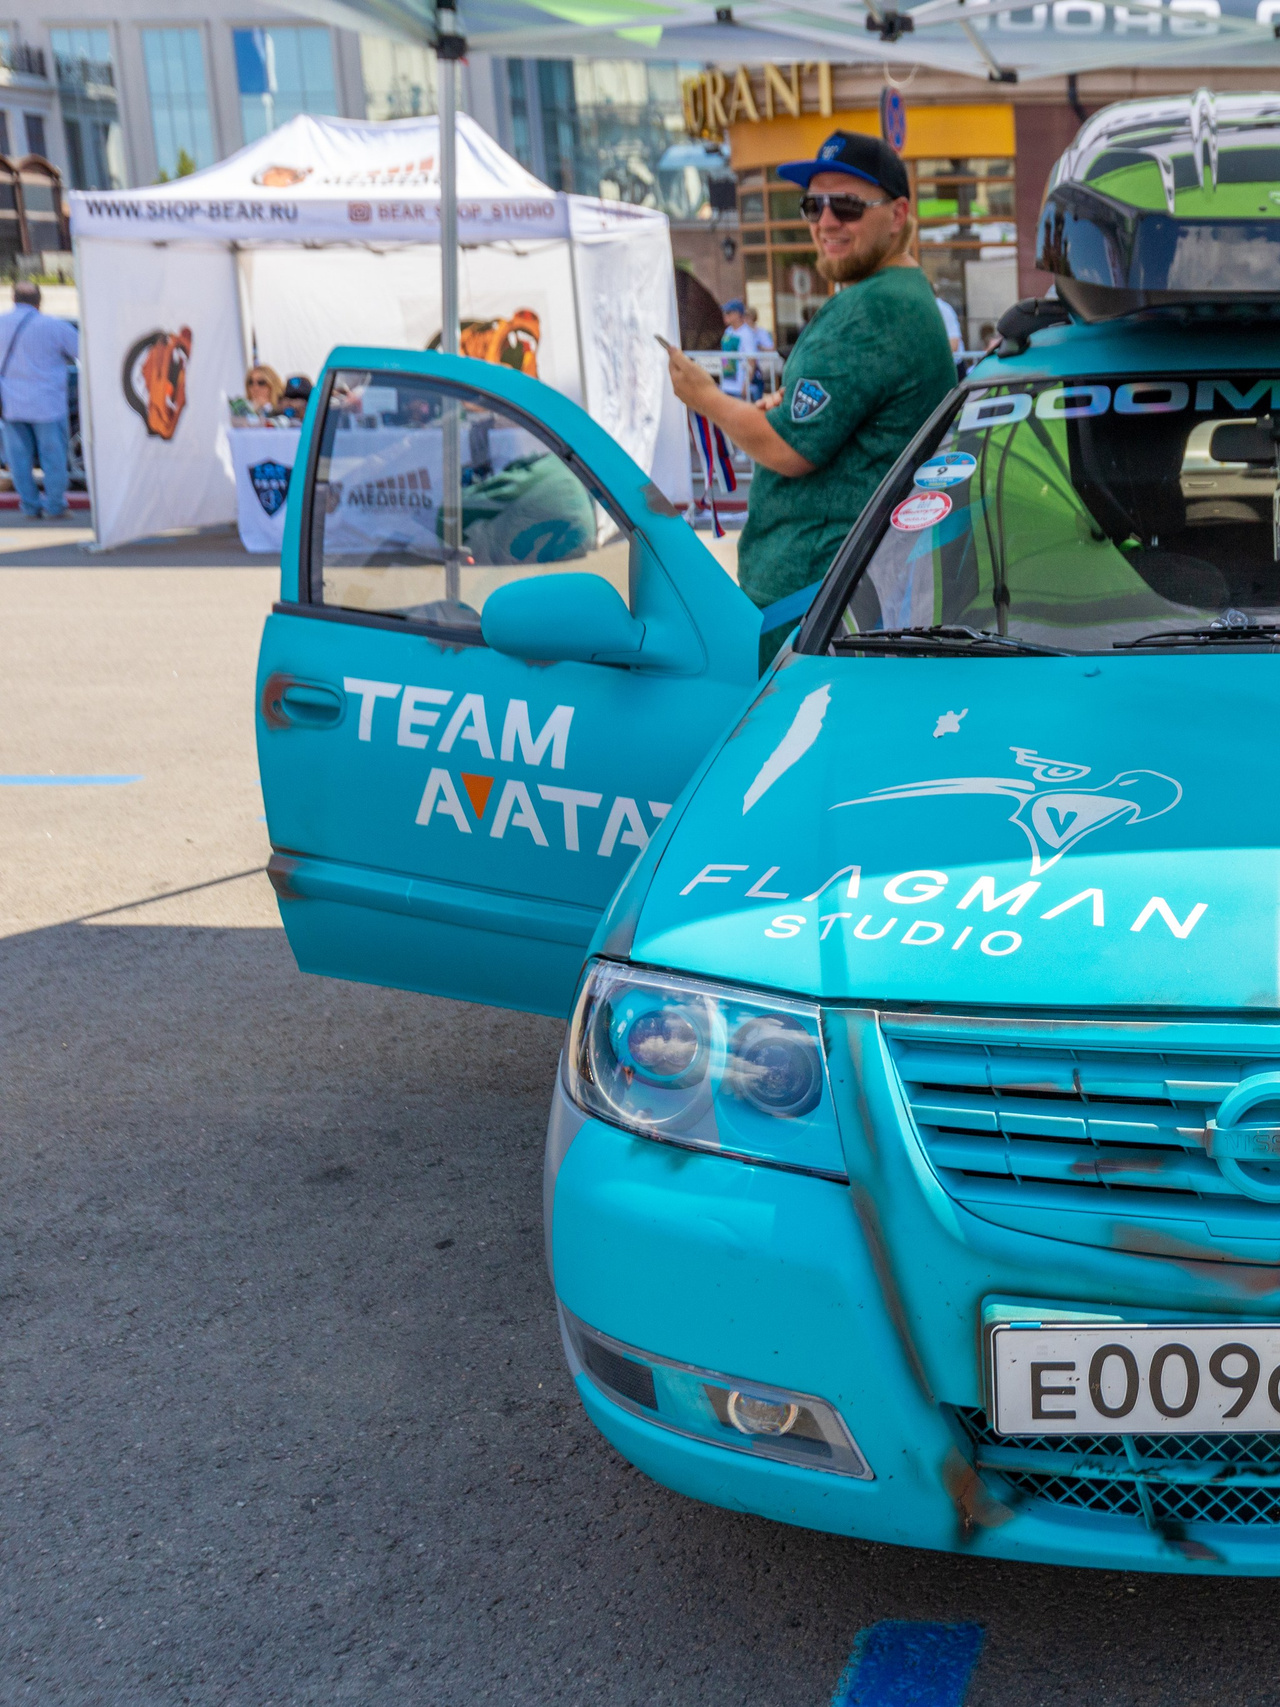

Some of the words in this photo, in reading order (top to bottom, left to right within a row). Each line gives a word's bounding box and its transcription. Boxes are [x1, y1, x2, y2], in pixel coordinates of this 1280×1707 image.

[86, 200, 298, 221] WWW.SHOP-BEAR.RU
[378, 202, 556, 224] BEAR_OP_STUDIO
[343, 676, 575, 770] TEAM
[679, 864, 1208, 939] FLAGMAN
[764, 912, 1022, 956] STUDIO
